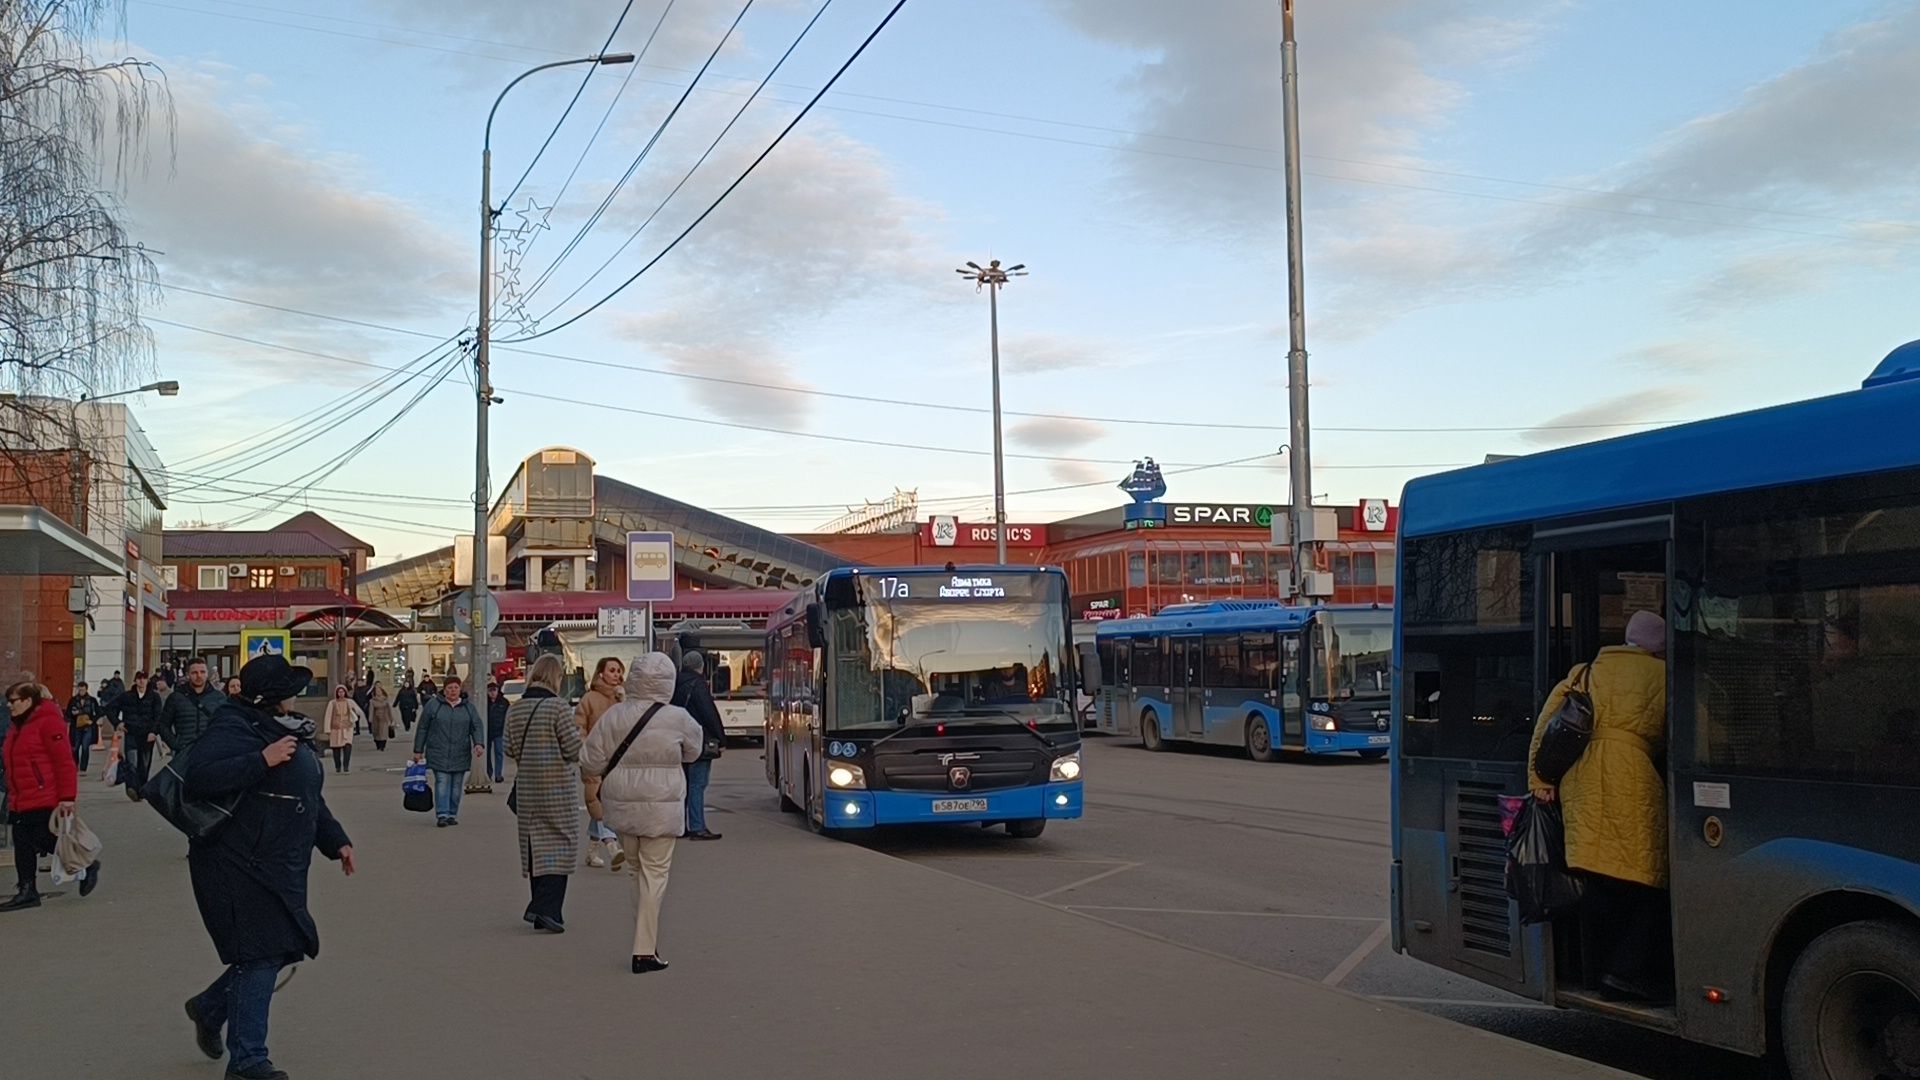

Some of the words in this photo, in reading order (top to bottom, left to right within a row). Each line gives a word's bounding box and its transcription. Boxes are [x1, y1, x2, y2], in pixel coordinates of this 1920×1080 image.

[1173, 506, 1250, 523] SPAR
[971, 527, 1032, 541] ROSIC'S
[1090, 599, 1110, 610] SPAR
[184, 609, 285, 622] АЛКОМАРКЕТ
